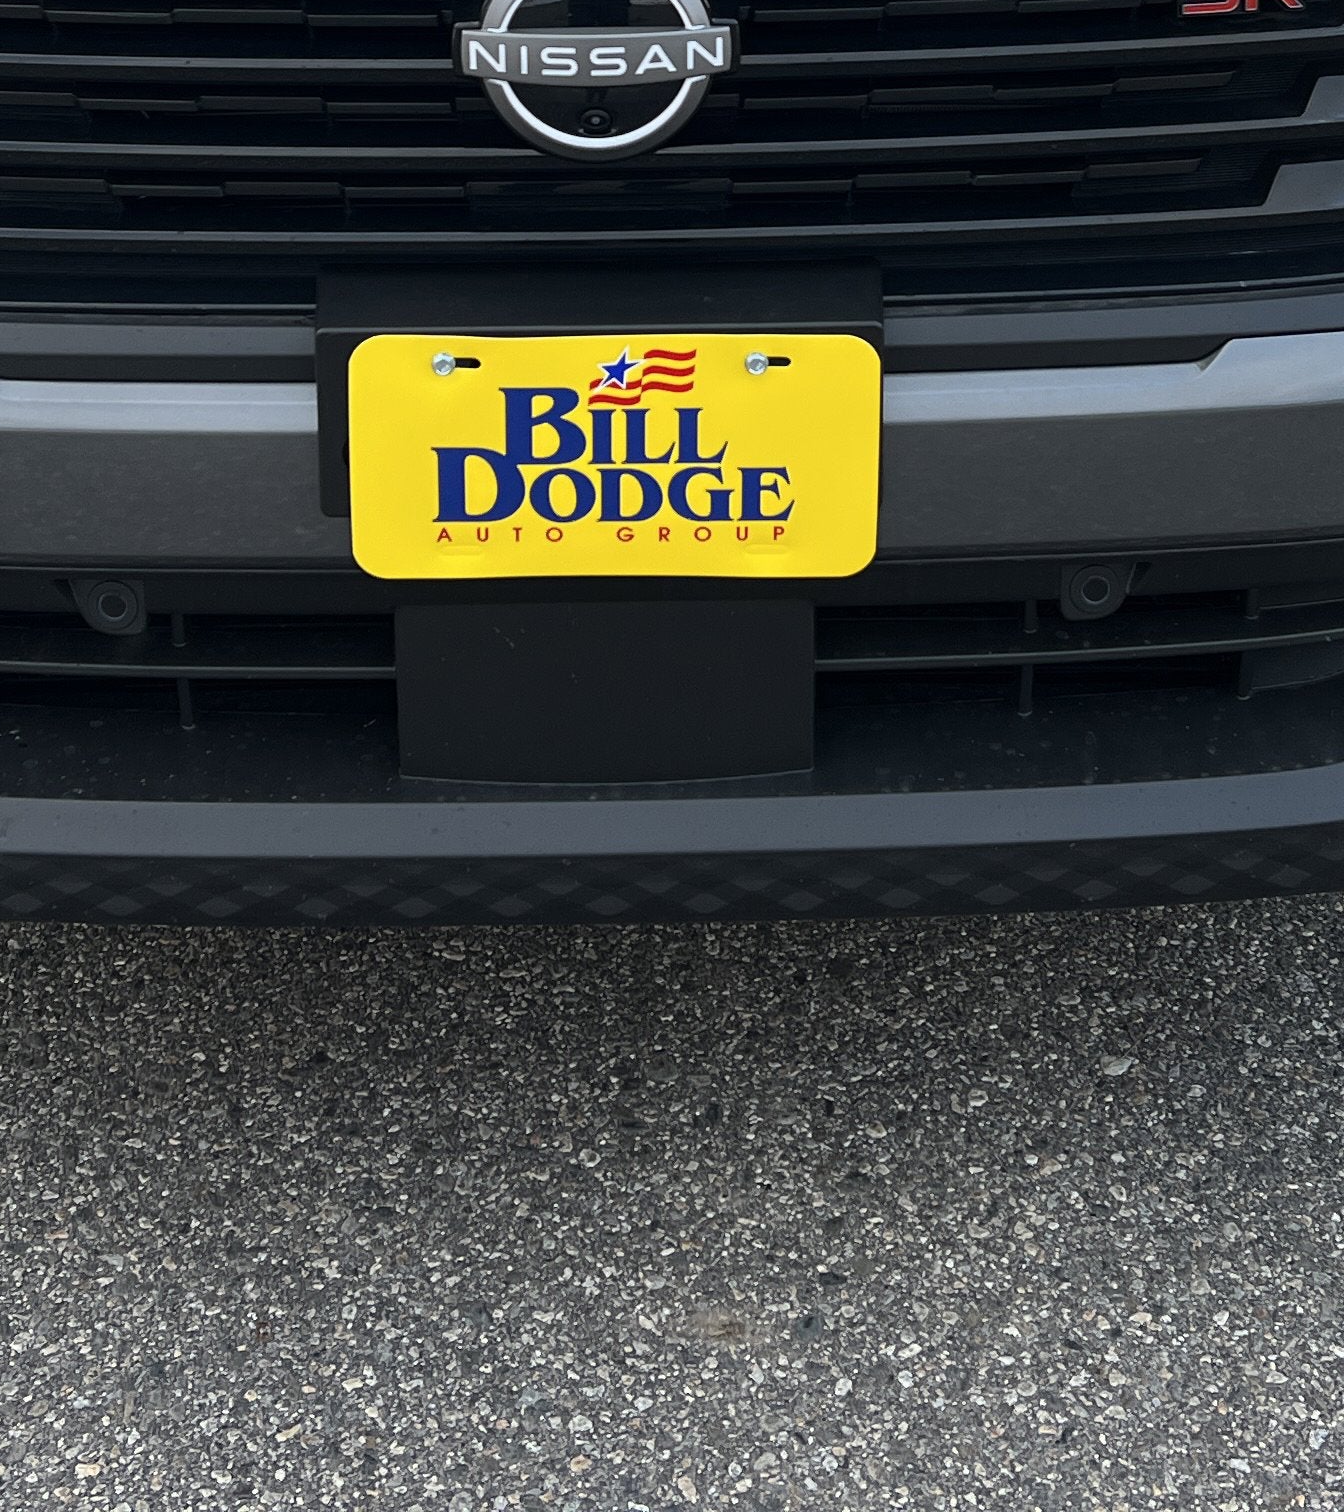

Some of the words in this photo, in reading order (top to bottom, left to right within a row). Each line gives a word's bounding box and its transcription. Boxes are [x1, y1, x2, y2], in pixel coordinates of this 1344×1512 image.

[468, 37, 724, 77] NISSAN
[498, 387, 729, 465] BILL
[430, 447, 796, 523] DODGE
[436, 526, 564, 543] AUTO
[616, 526, 786, 543] GROUP
